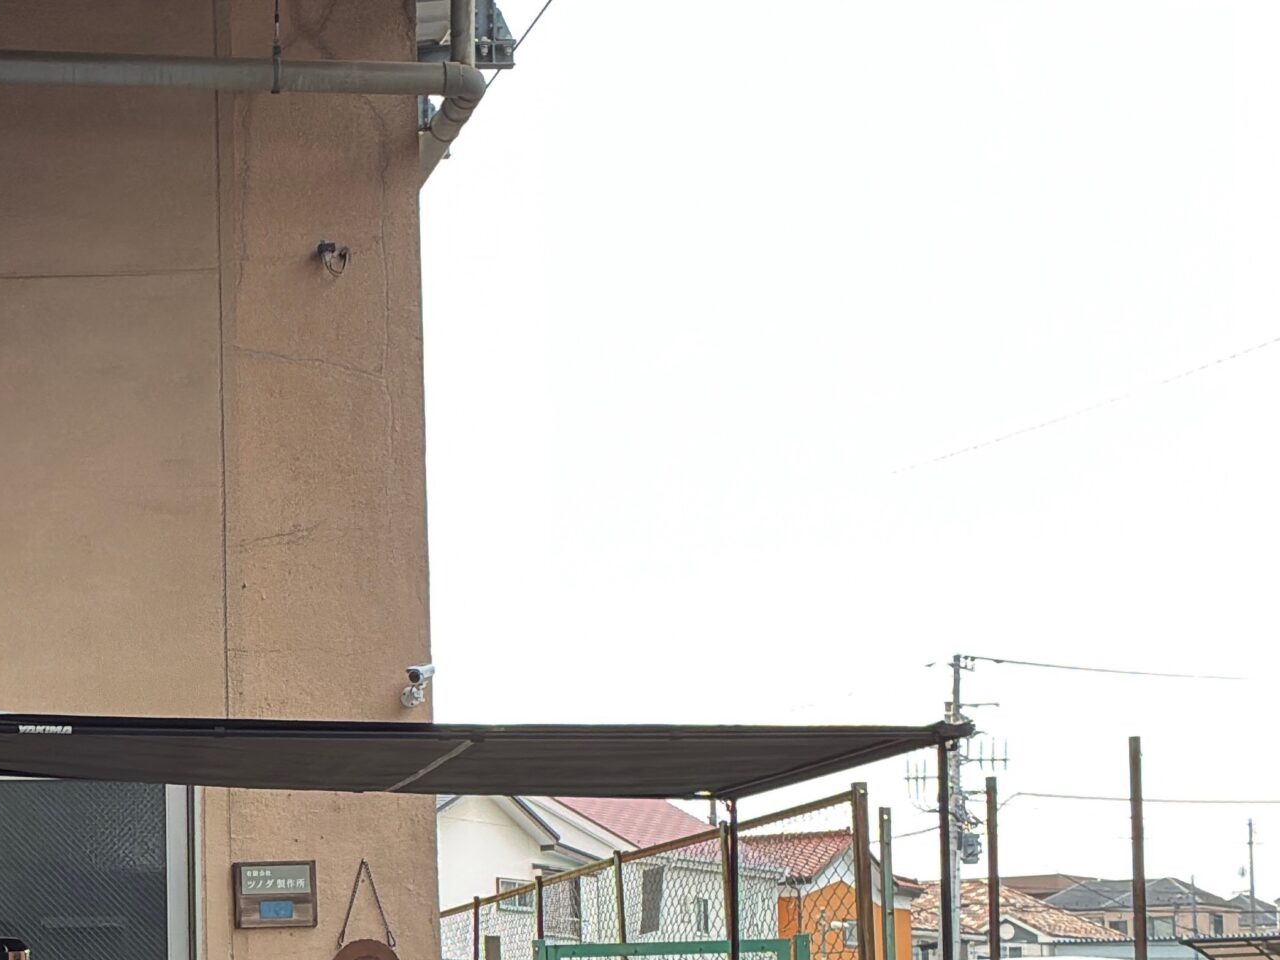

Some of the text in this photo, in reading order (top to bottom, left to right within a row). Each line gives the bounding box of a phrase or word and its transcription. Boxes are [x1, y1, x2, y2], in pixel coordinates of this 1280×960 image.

[18, 725, 73, 735] YAKIMA
[247, 879, 305, 888] ツノダ製作所
